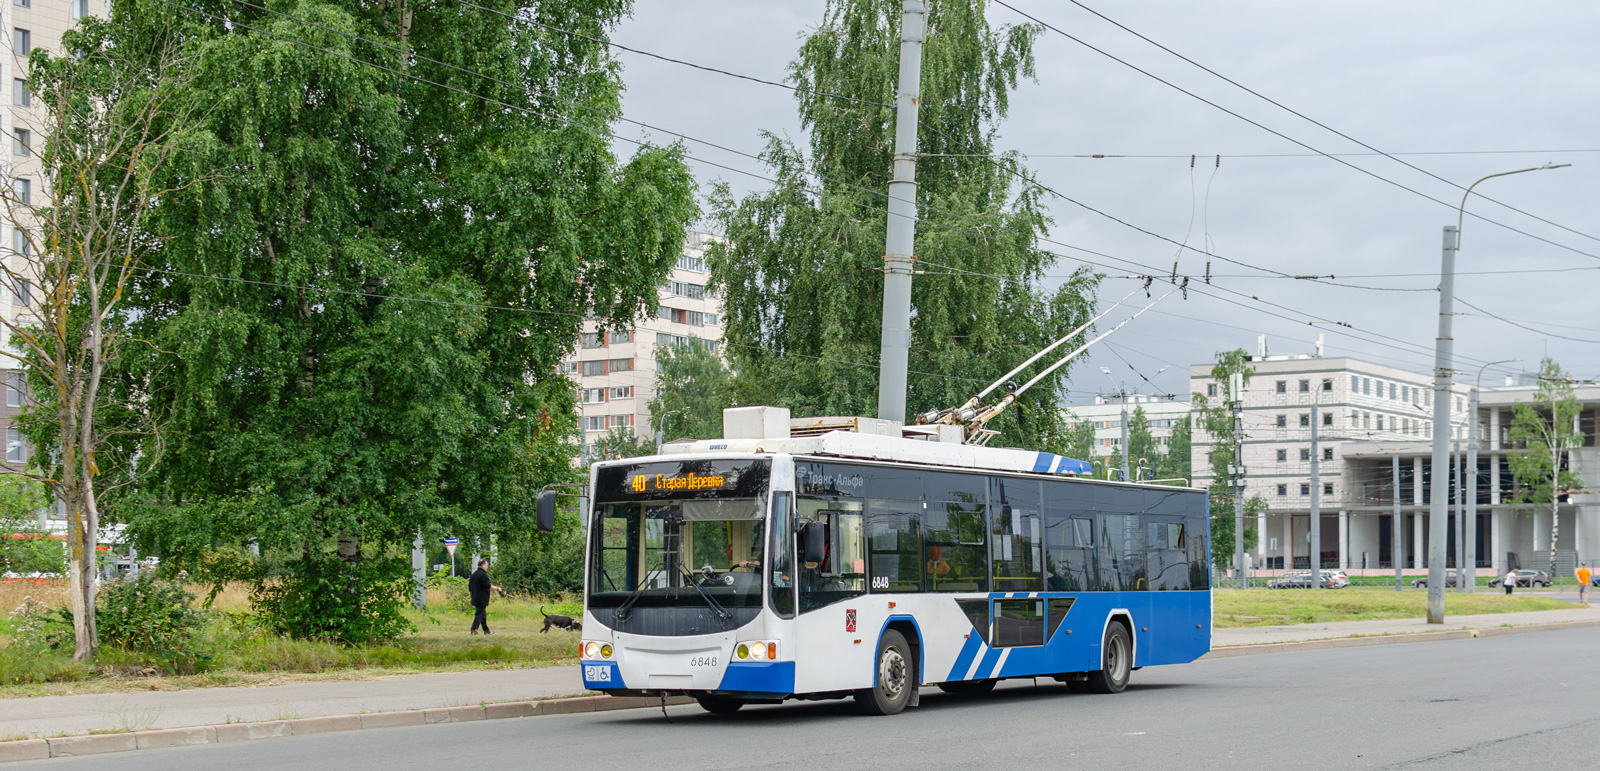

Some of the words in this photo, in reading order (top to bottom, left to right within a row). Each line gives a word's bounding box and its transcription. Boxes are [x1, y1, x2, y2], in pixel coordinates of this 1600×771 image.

[632, 474, 646, 492] 40
[656, 473, 687, 491] Старая
[687, 472, 724, 490] Деревня
[807, 471, 864, 490] Транс-Альфа
[872, 576, 889, 589] 6848
[690, 656, 718, 667] 6848
